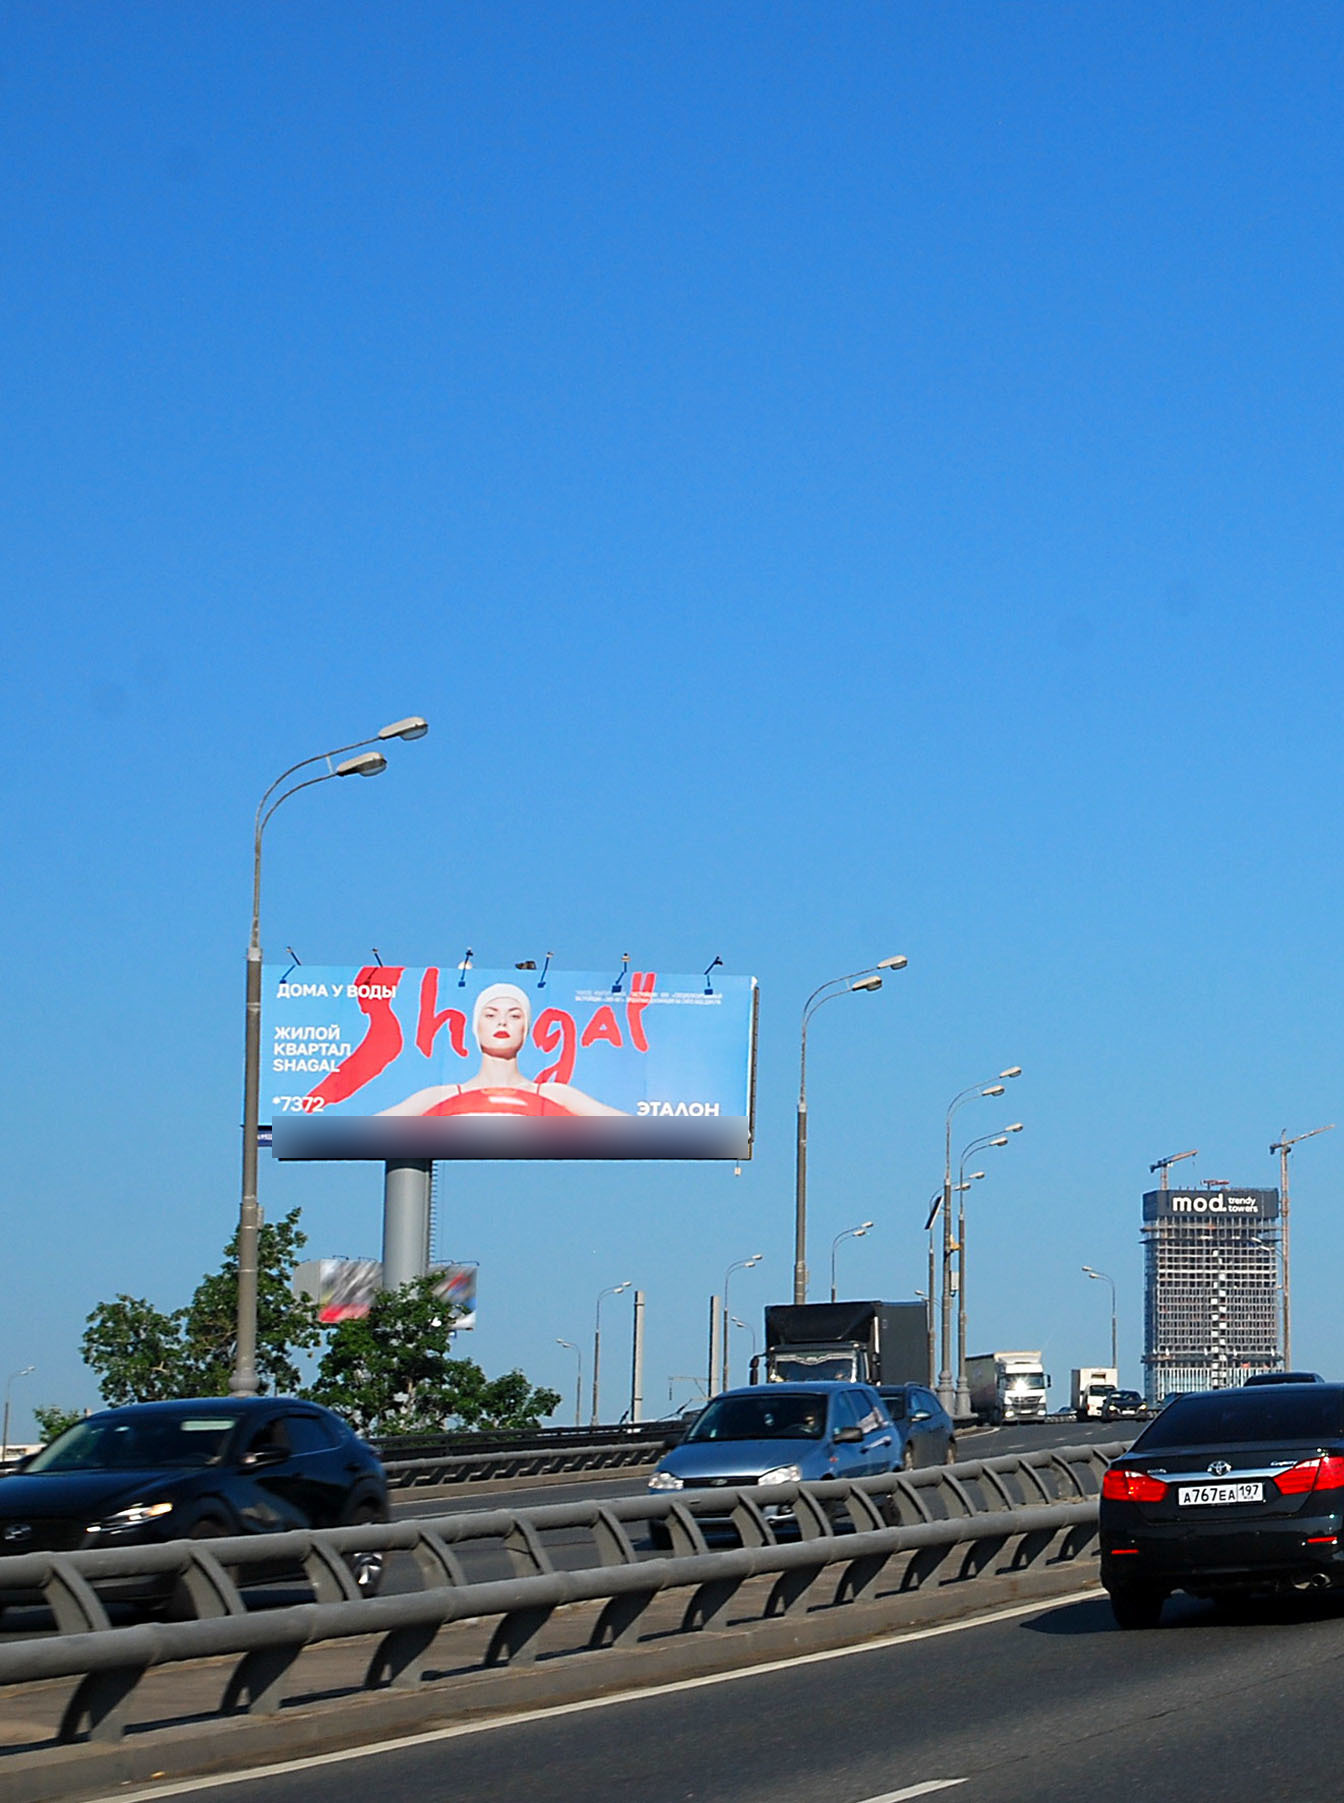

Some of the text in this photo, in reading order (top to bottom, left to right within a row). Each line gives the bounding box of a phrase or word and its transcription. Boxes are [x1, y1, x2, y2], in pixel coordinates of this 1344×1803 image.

[276, 983, 397, 1000] ДОМА У ВОДЫ
[273, 1024, 340, 1041] ЖИЛОЙ
[273, 1043, 351, 1057] КВАРТАЛ
[272, 1059, 340, 1072] SHAGAL
[636, 1101, 720, 1117] ЭТАЛОН
[1172, 1193, 1256, 1212] mod. trendy
[1228, 1205, 1258, 1213] towers
[1184, 1485, 1259, 1503] А767ЕА 197
